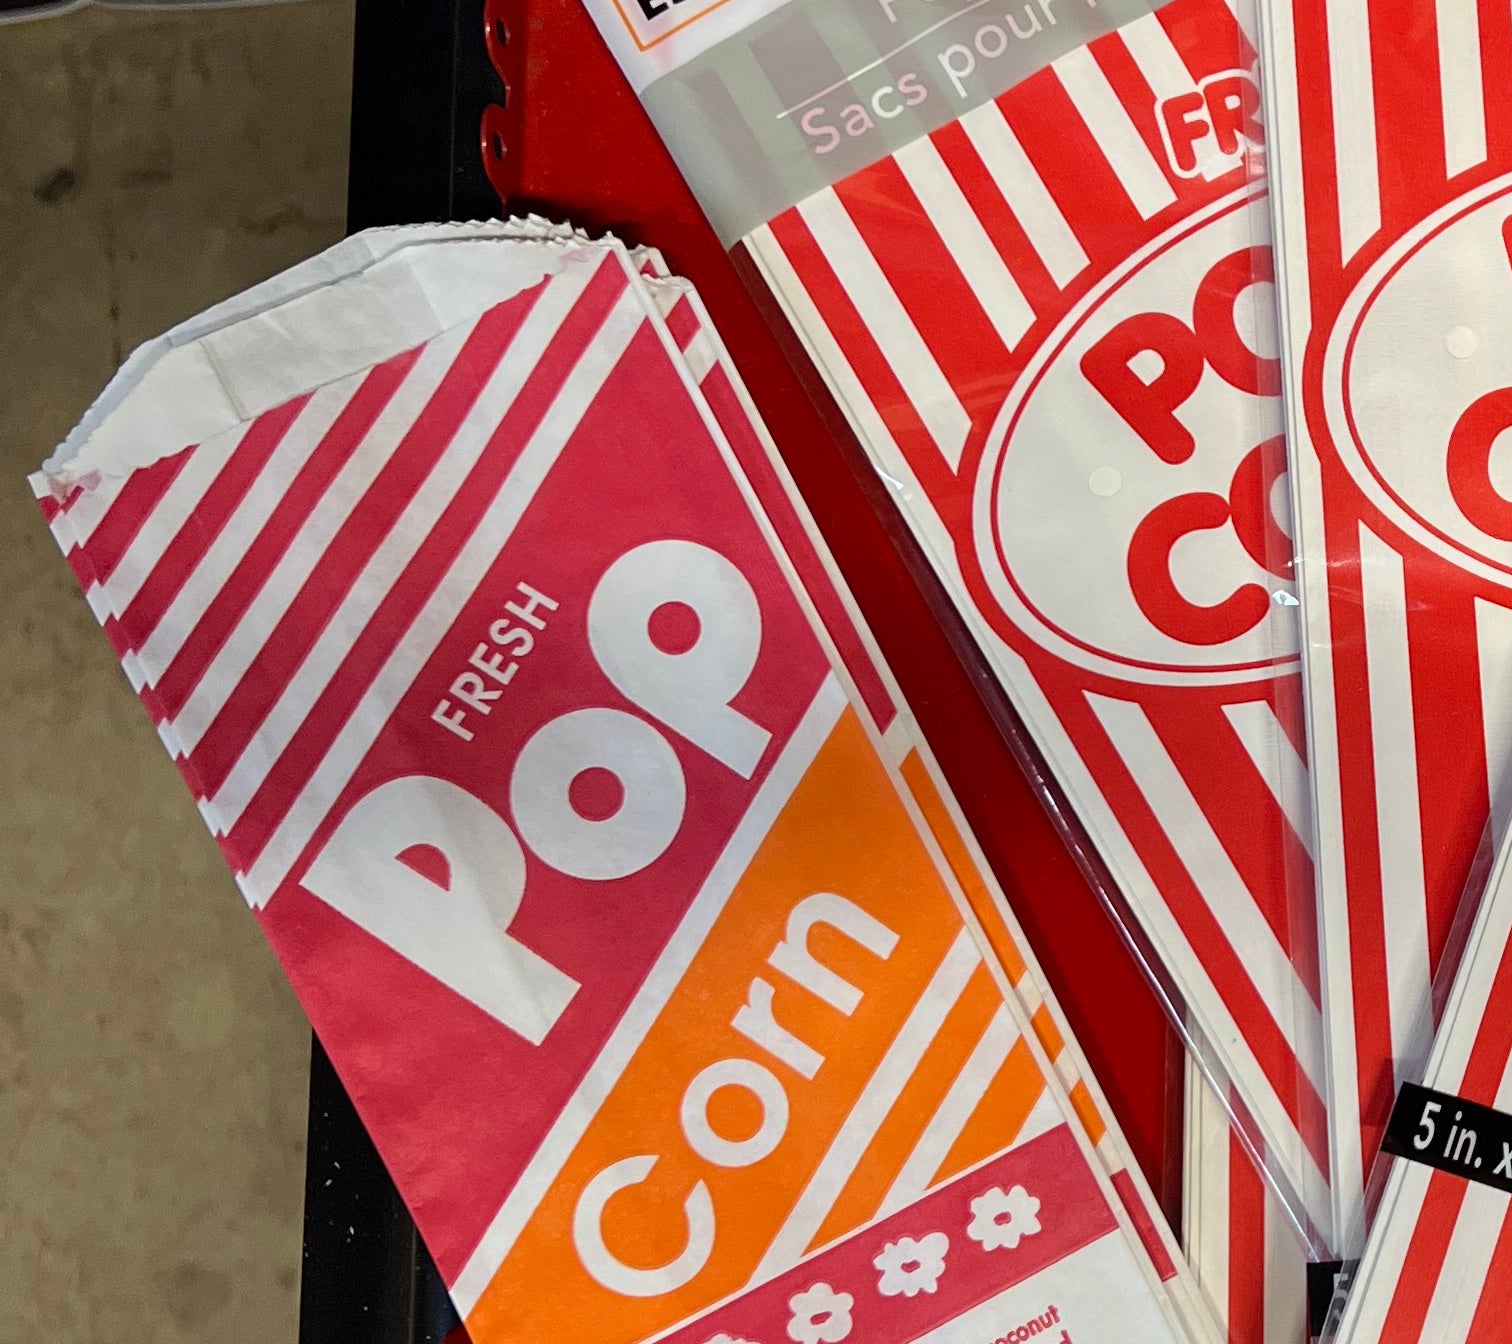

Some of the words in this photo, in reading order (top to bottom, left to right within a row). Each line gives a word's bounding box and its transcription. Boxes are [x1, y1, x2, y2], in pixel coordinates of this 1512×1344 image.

[800, 64, 929, 155] Sacs
[1079, 245, 1280, 466] PO
[431, 581, 560, 742] FRESH
[573, 891, 900, 1298] Corn
[1413, 1101, 1442, 1151] 5
[1443, 1111, 1482, 1169] in.
